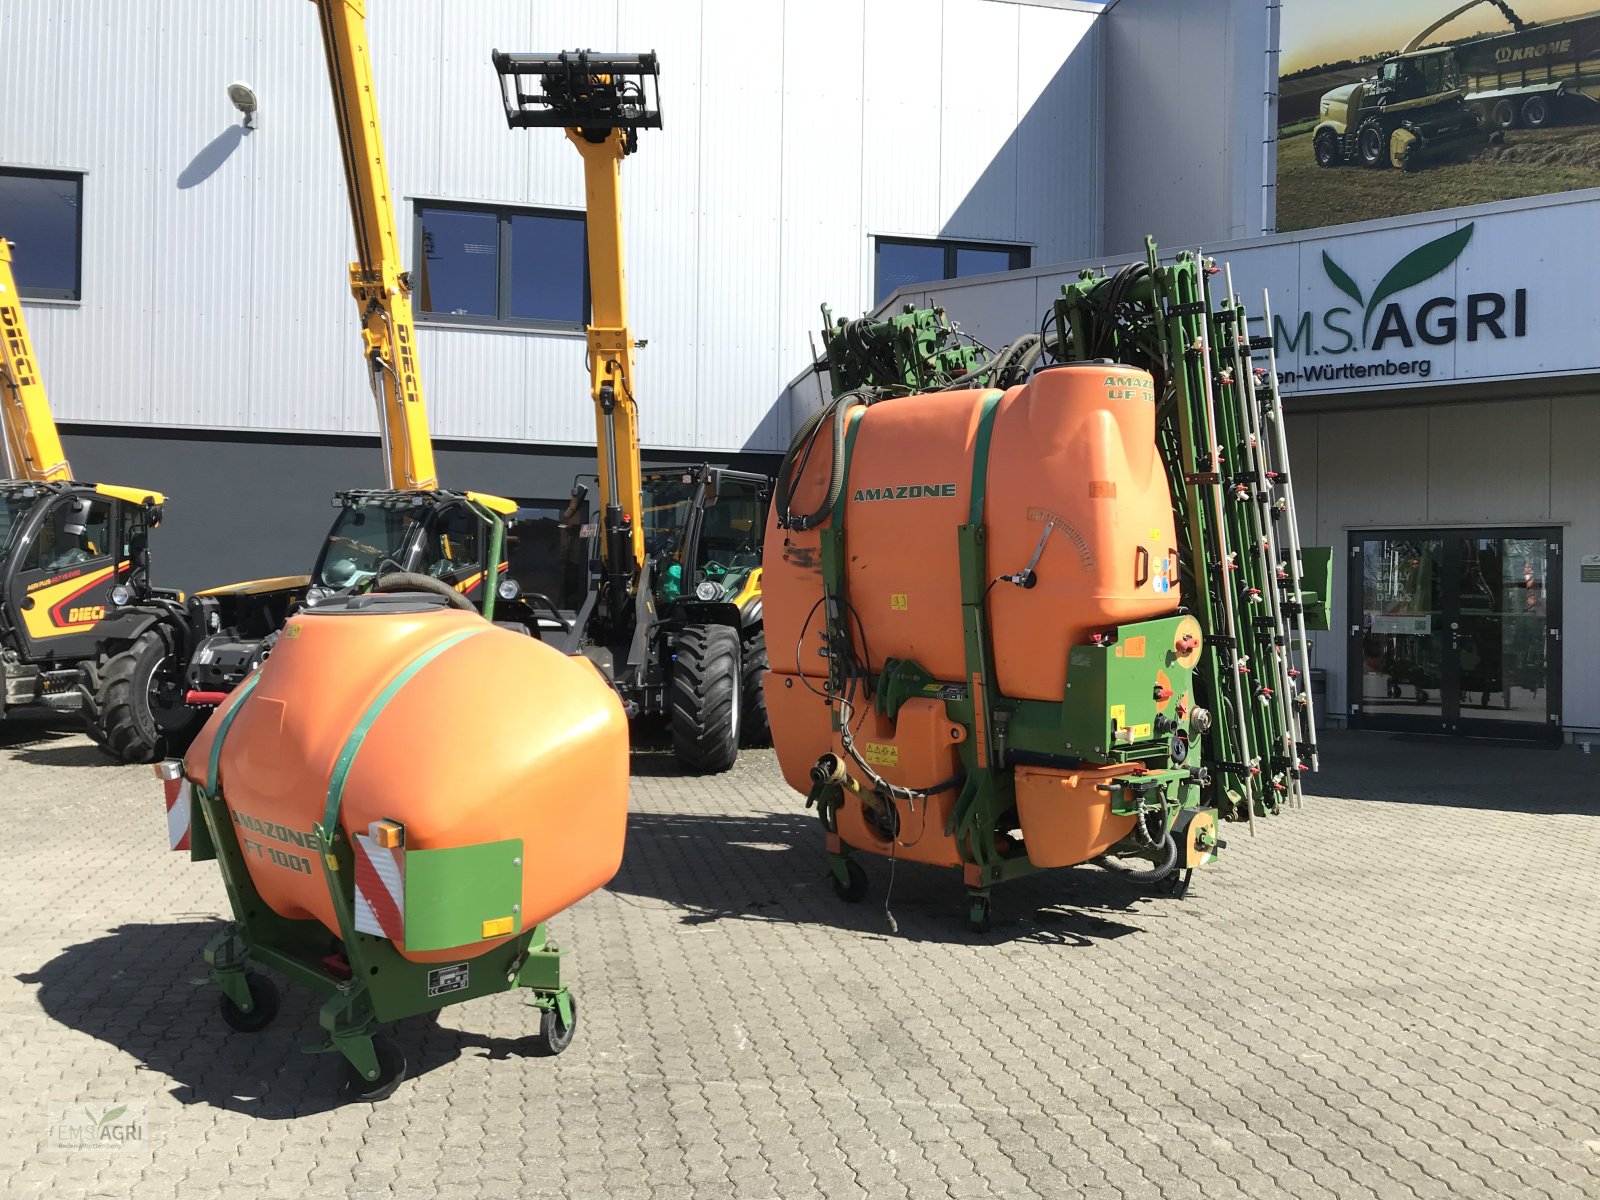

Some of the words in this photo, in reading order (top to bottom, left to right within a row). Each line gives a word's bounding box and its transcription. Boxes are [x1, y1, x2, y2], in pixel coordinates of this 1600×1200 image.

[1512, 39, 1571, 61] KRONE
[1371, 288, 1527, 350] AGRI
[1261, 358, 1431, 385] en-Württemberg
[1108, 389, 1136, 400] UF
[853, 483, 957, 502] AMAZONE
[1376, 582, 1405, 591] BID
[1376, 592, 1412, 601] DEALS
[69, 605, 105, 623] DIECI
[232, 809, 321, 852] AMAZONE
[244, 838, 263, 859] FT
[267, 847, 313, 876] 1001
